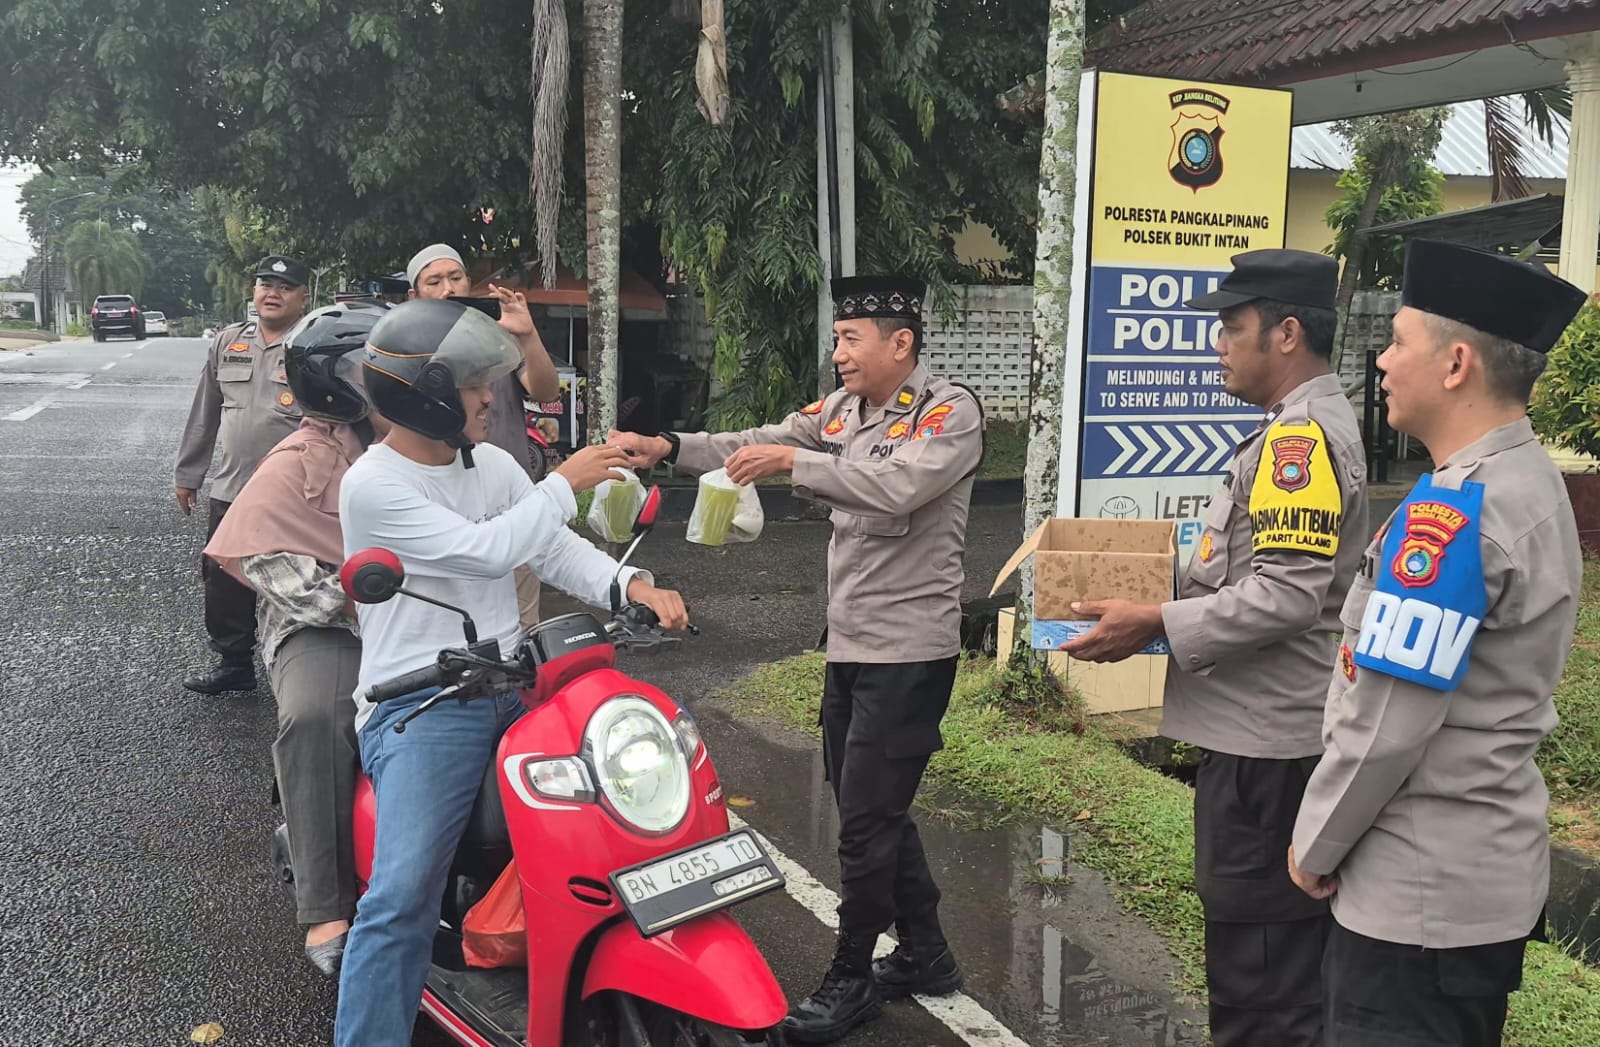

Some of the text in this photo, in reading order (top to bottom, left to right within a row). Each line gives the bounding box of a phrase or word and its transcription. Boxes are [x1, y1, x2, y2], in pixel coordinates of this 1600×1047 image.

[1104, 206, 1269, 229] POLRESTA PANGKALPINANG
[1124, 229, 1249, 249] POLSEK BUKIT INTAN
[1107, 369, 1185, 386] MELINDUNGI
[1188, 370, 1198, 386] &
[1100, 392, 1114, 408] TO
[1119, 391, 1160, 408] SERVE
[1163, 391, 1188, 407] AND
[1191, 391, 1207, 408] TO
[1409, 503, 1464, 528] POLRESTA
[1266, 533, 1293, 544] PARIT
[1296, 534, 1332, 549] LALANG
[563, 631, 598, 645] HONDA
[1356, 590, 1480, 681] ROV
[626, 874, 658, 900] BN
[670, 851, 720, 886] 4855
